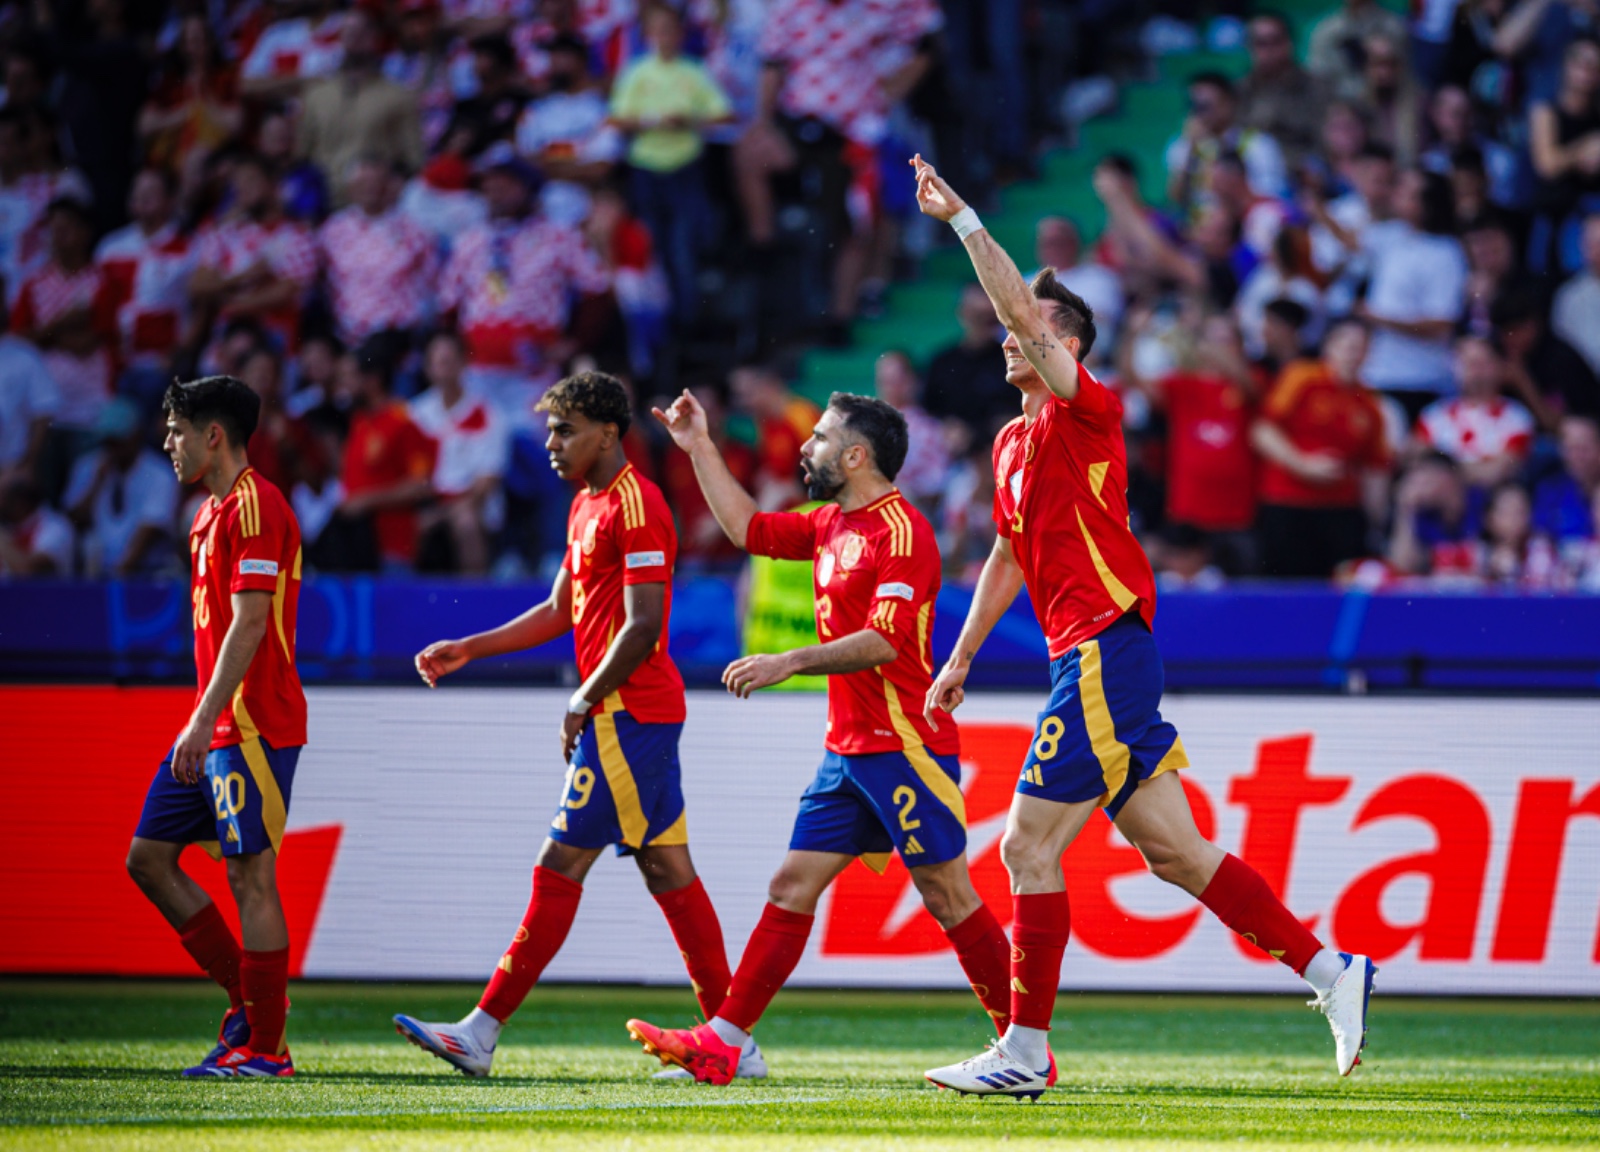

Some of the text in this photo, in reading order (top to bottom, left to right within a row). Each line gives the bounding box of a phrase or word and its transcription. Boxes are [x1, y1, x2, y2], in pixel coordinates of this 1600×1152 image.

[1034, 715, 1066, 761] 8
[212, 771, 246, 820] 20
[560, 763, 596, 810] 19
[892, 784, 921, 832] 2
